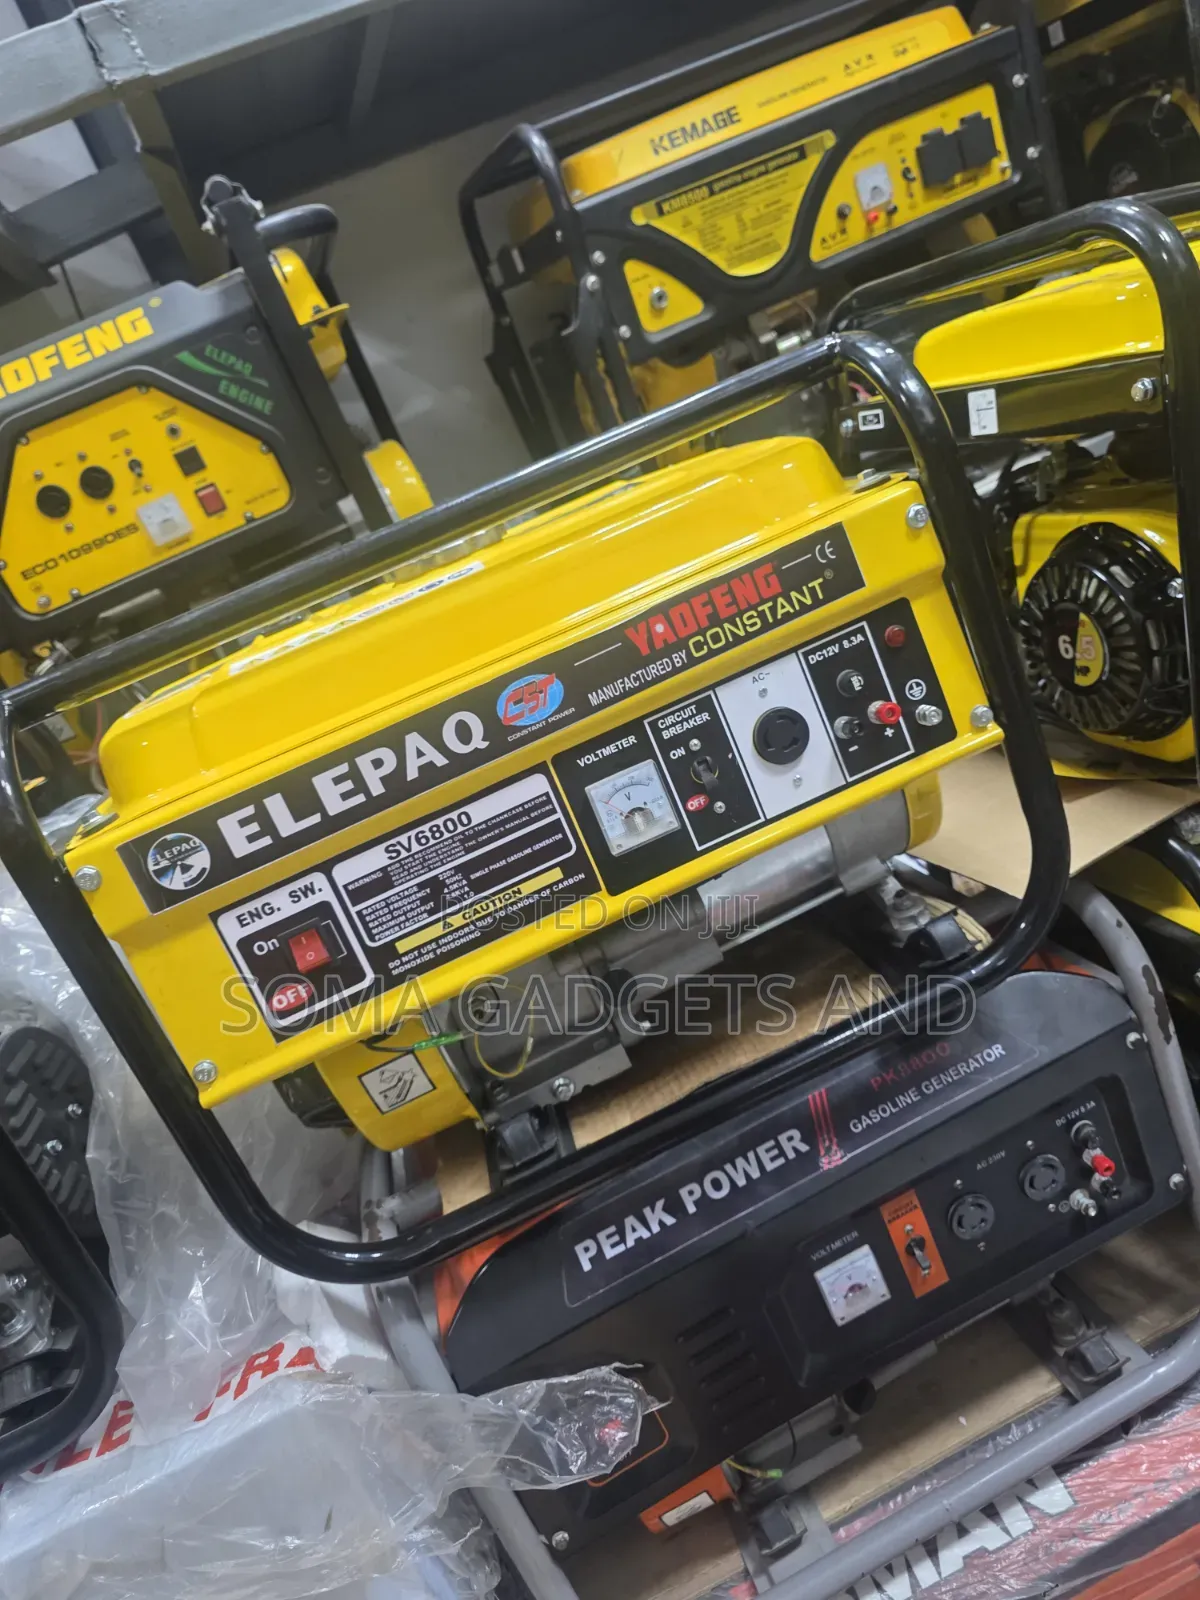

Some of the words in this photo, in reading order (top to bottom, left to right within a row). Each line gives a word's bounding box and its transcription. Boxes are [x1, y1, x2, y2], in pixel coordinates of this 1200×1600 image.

[649, 105, 743, 156] KEMAGE
[218, 378, 274, 415] ENGINE
[624, 563, 783, 656] YAOFENG
[588, 657, 673, 706] MANUFACTURED
[673, 650, 689, 667] BY
[688, 577, 825, 660] CONSTANT
[807, 643, 841, 665] DC12V
[842, 633, 866, 651] 8.3A
[1057, 634, 1096, 660] 6.5
[502, 673, 557, 726] CST
[657, 705, 698, 730] CIRCUIT
[507, 720, 546, 742] CONSTANT
[547, 706, 576, 724] POWER
[661, 712, 711, 740] BREAKER
[576, 735, 638, 768] VOLTMETER
[669, 746, 686, 760] ON
[216, 710, 491, 859] ELEPAQ
[687, 798, 707, 812] OFF
[383, 810, 473, 861] SV6800
[401, 857, 412, 865] THE
[524, 796, 546, 809] BEFORE
[409, 864, 422, 873] AND
[423, 846, 463, 866] UNDERSTAND
[505, 815, 529, 829] MANUAL
[530, 804, 552, 817] BEFORE
[390, 867, 402, 875] YOU
[404, 858, 422, 869] START
[425, 852, 436, 860] THE
[438, 841, 460, 854] ENGINE
[394, 867, 428, 885] OPERATING
[430, 861, 441, 869] THE
[443, 850, 464, 863] ENGINE
[470, 868, 488, 879] SINGLE
[490, 860, 506, 870] PHASE
[507, 848, 532, 862] GASOLINE
[533, 833, 562, 850] GENERATOR
[348, 871, 382, 890] WARNING
[362, 901, 385, 915] RATED
[387, 886, 417, 903] VOLTAGE
[439, 869, 455, 880] 220V
[365, 907, 388, 921] RATED
[390, 888, 430, 910] FREQUENCY
[446, 873, 462, 884] 50HZ
[236, 900, 282, 929] ENG.
[288, 881, 324, 904] SW.
[369, 914, 391, 928] RATED
[393, 900, 421, 917] OUTPUT
[372, 915, 405, 934] MAXIMUM
[407, 902, 434, 918] OUTPUT
[389, 959, 400, 968] DO
[402, 951, 419, 962] NOT
[421, 942, 437, 953] USE
[439, 925, 474, 945] INDOORS
[476, 916, 492, 927] DUE
[495, 910, 505, 918] TO
[507, 894, 539, 913] DANGER
[541, 888, 551, 897] OF
[553, 873, 585, 891] CARBON
[461, 887, 522, 920] CAUTION
[375, 926, 399, 941] POWER
[401, 913, 428, 928] FACTOR
[253, 936, 280, 957] On
[391, 952, 434, 975] MONOXIDE
[436, 930, 480, 955] POISONING
[271, 983, 310, 1011] OFF
[849, 1081, 921, 1134] GASOLINE
[920, 1042, 1007, 1098] GENERATOR
[574, 1197, 677, 1273] PEAK
[677, 1127, 810, 1214] POWER
